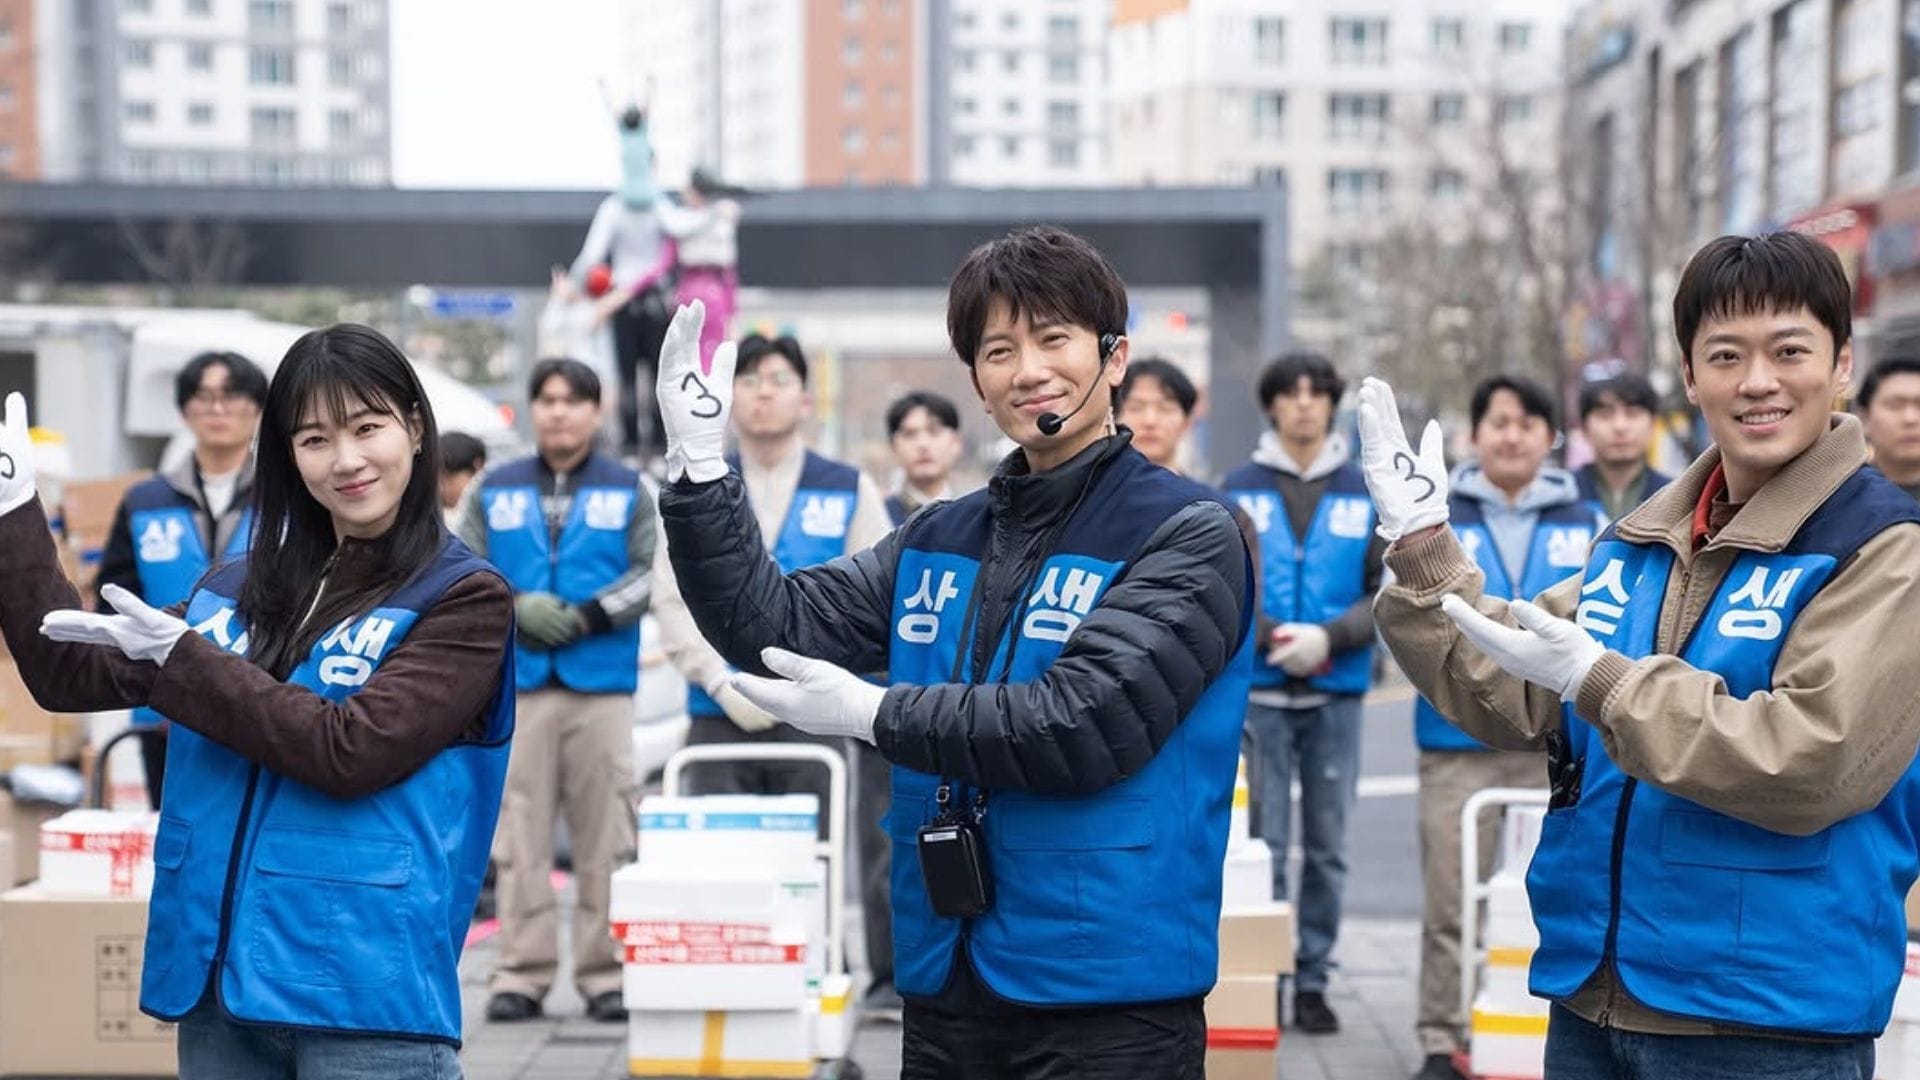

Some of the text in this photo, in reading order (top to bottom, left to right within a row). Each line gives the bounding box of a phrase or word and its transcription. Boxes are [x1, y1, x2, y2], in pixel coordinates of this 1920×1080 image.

[681, 371, 722, 418] 3
[1394, 451, 1435, 503] 3
[897, 567, 1103, 644] 상 생
[1718, 566, 1803, 640] 생
[319, 615, 396, 687] 생
